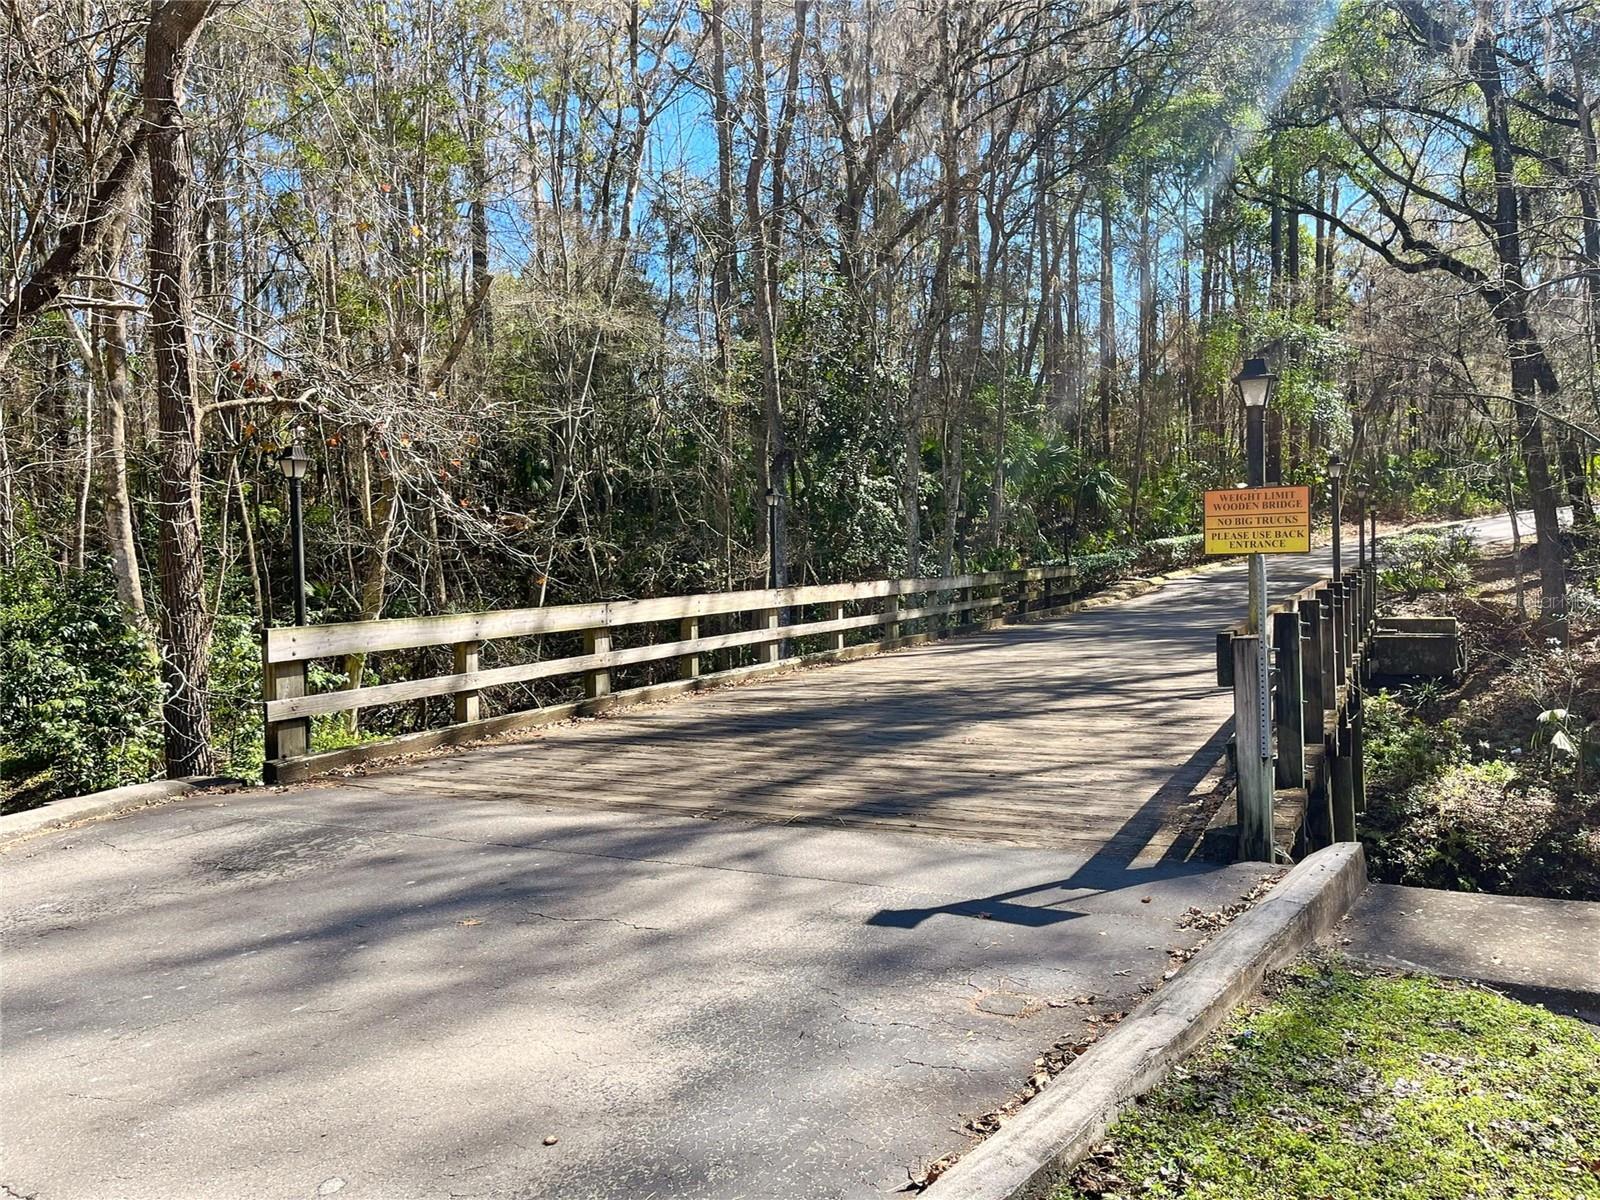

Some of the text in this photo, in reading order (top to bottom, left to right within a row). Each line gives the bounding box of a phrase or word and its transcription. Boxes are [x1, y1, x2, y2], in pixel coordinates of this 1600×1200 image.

[1219, 491, 1295, 502] WEIGHT LIMIT
[1213, 500, 1303, 512] WOODEN BRIDGE
[1217, 515, 1298, 526] NO BIG TRUCKS
[1211, 531, 1249, 540] PLEASE
[1275, 529, 1305, 538] BACK
[1229, 539, 1286, 549] ENTRANCE
